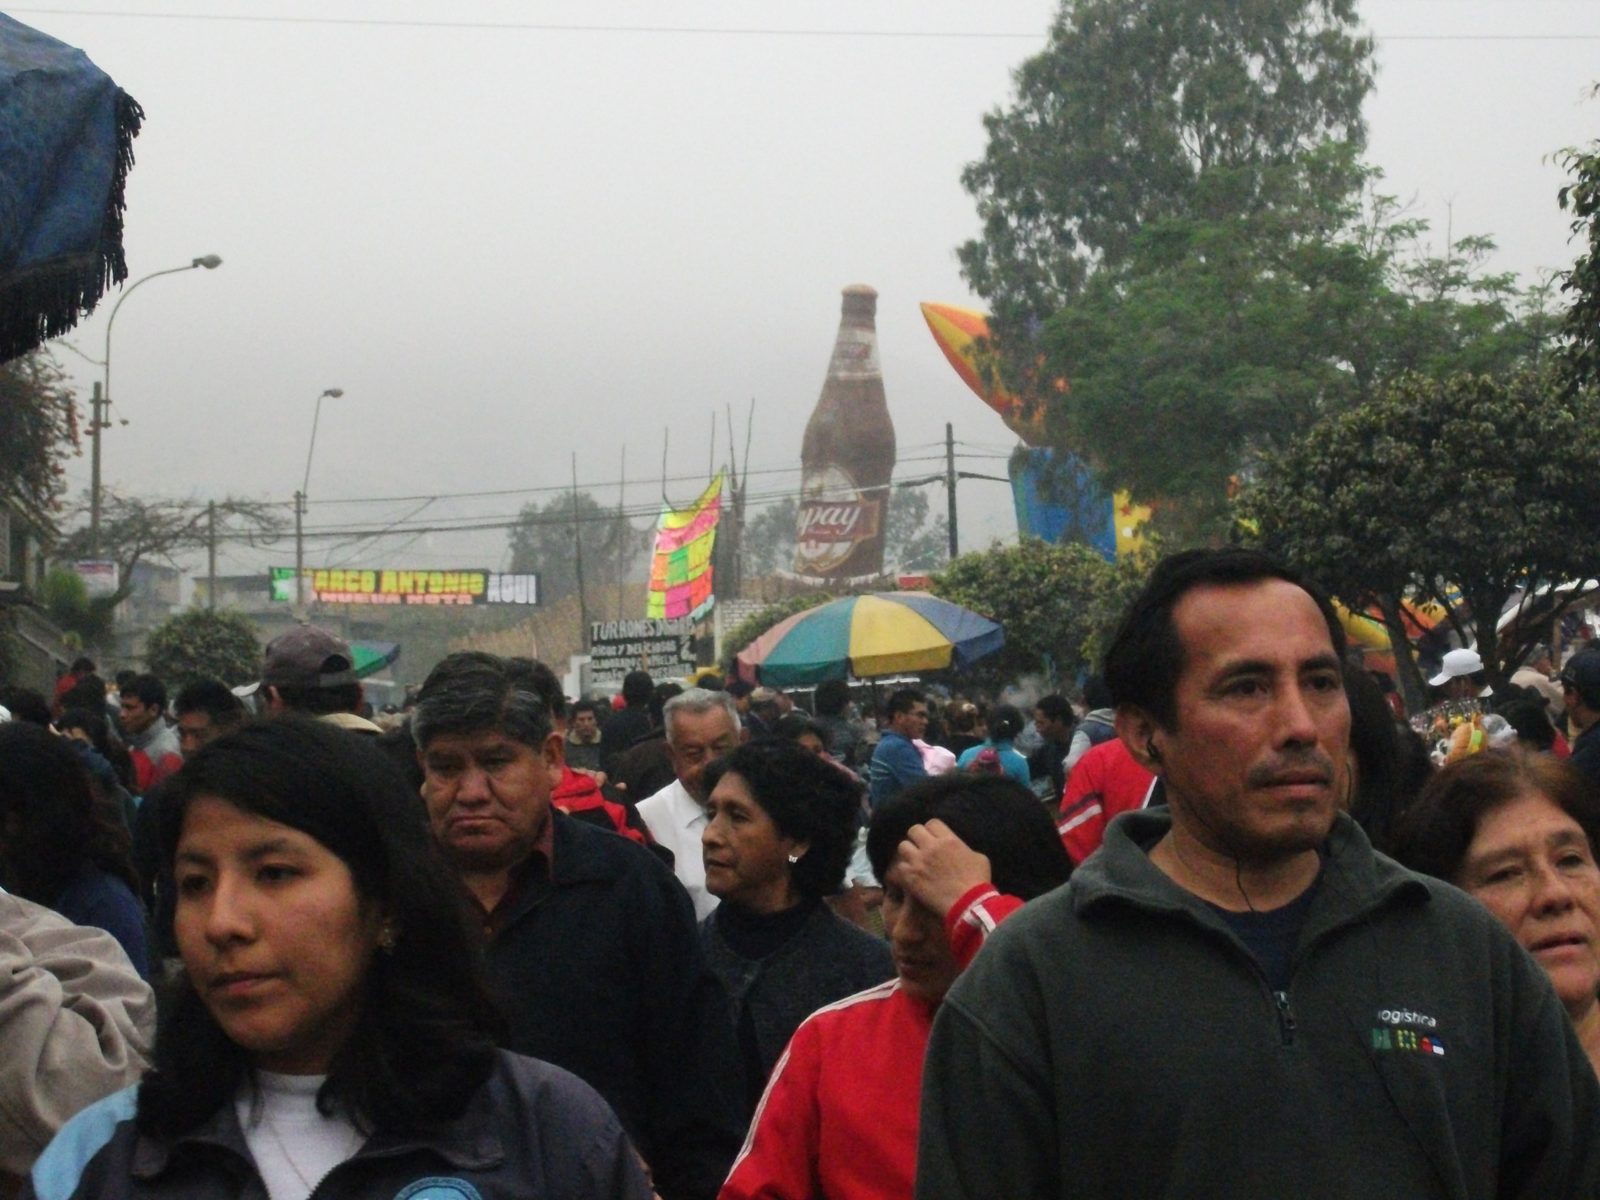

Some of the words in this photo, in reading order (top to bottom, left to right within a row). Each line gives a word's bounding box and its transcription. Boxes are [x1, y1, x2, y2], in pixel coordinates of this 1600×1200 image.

[304, 569, 376, 593] ARCO
[381, 570, 485, 595] ANTONIO
[592, 620, 655, 641] TURRONES
